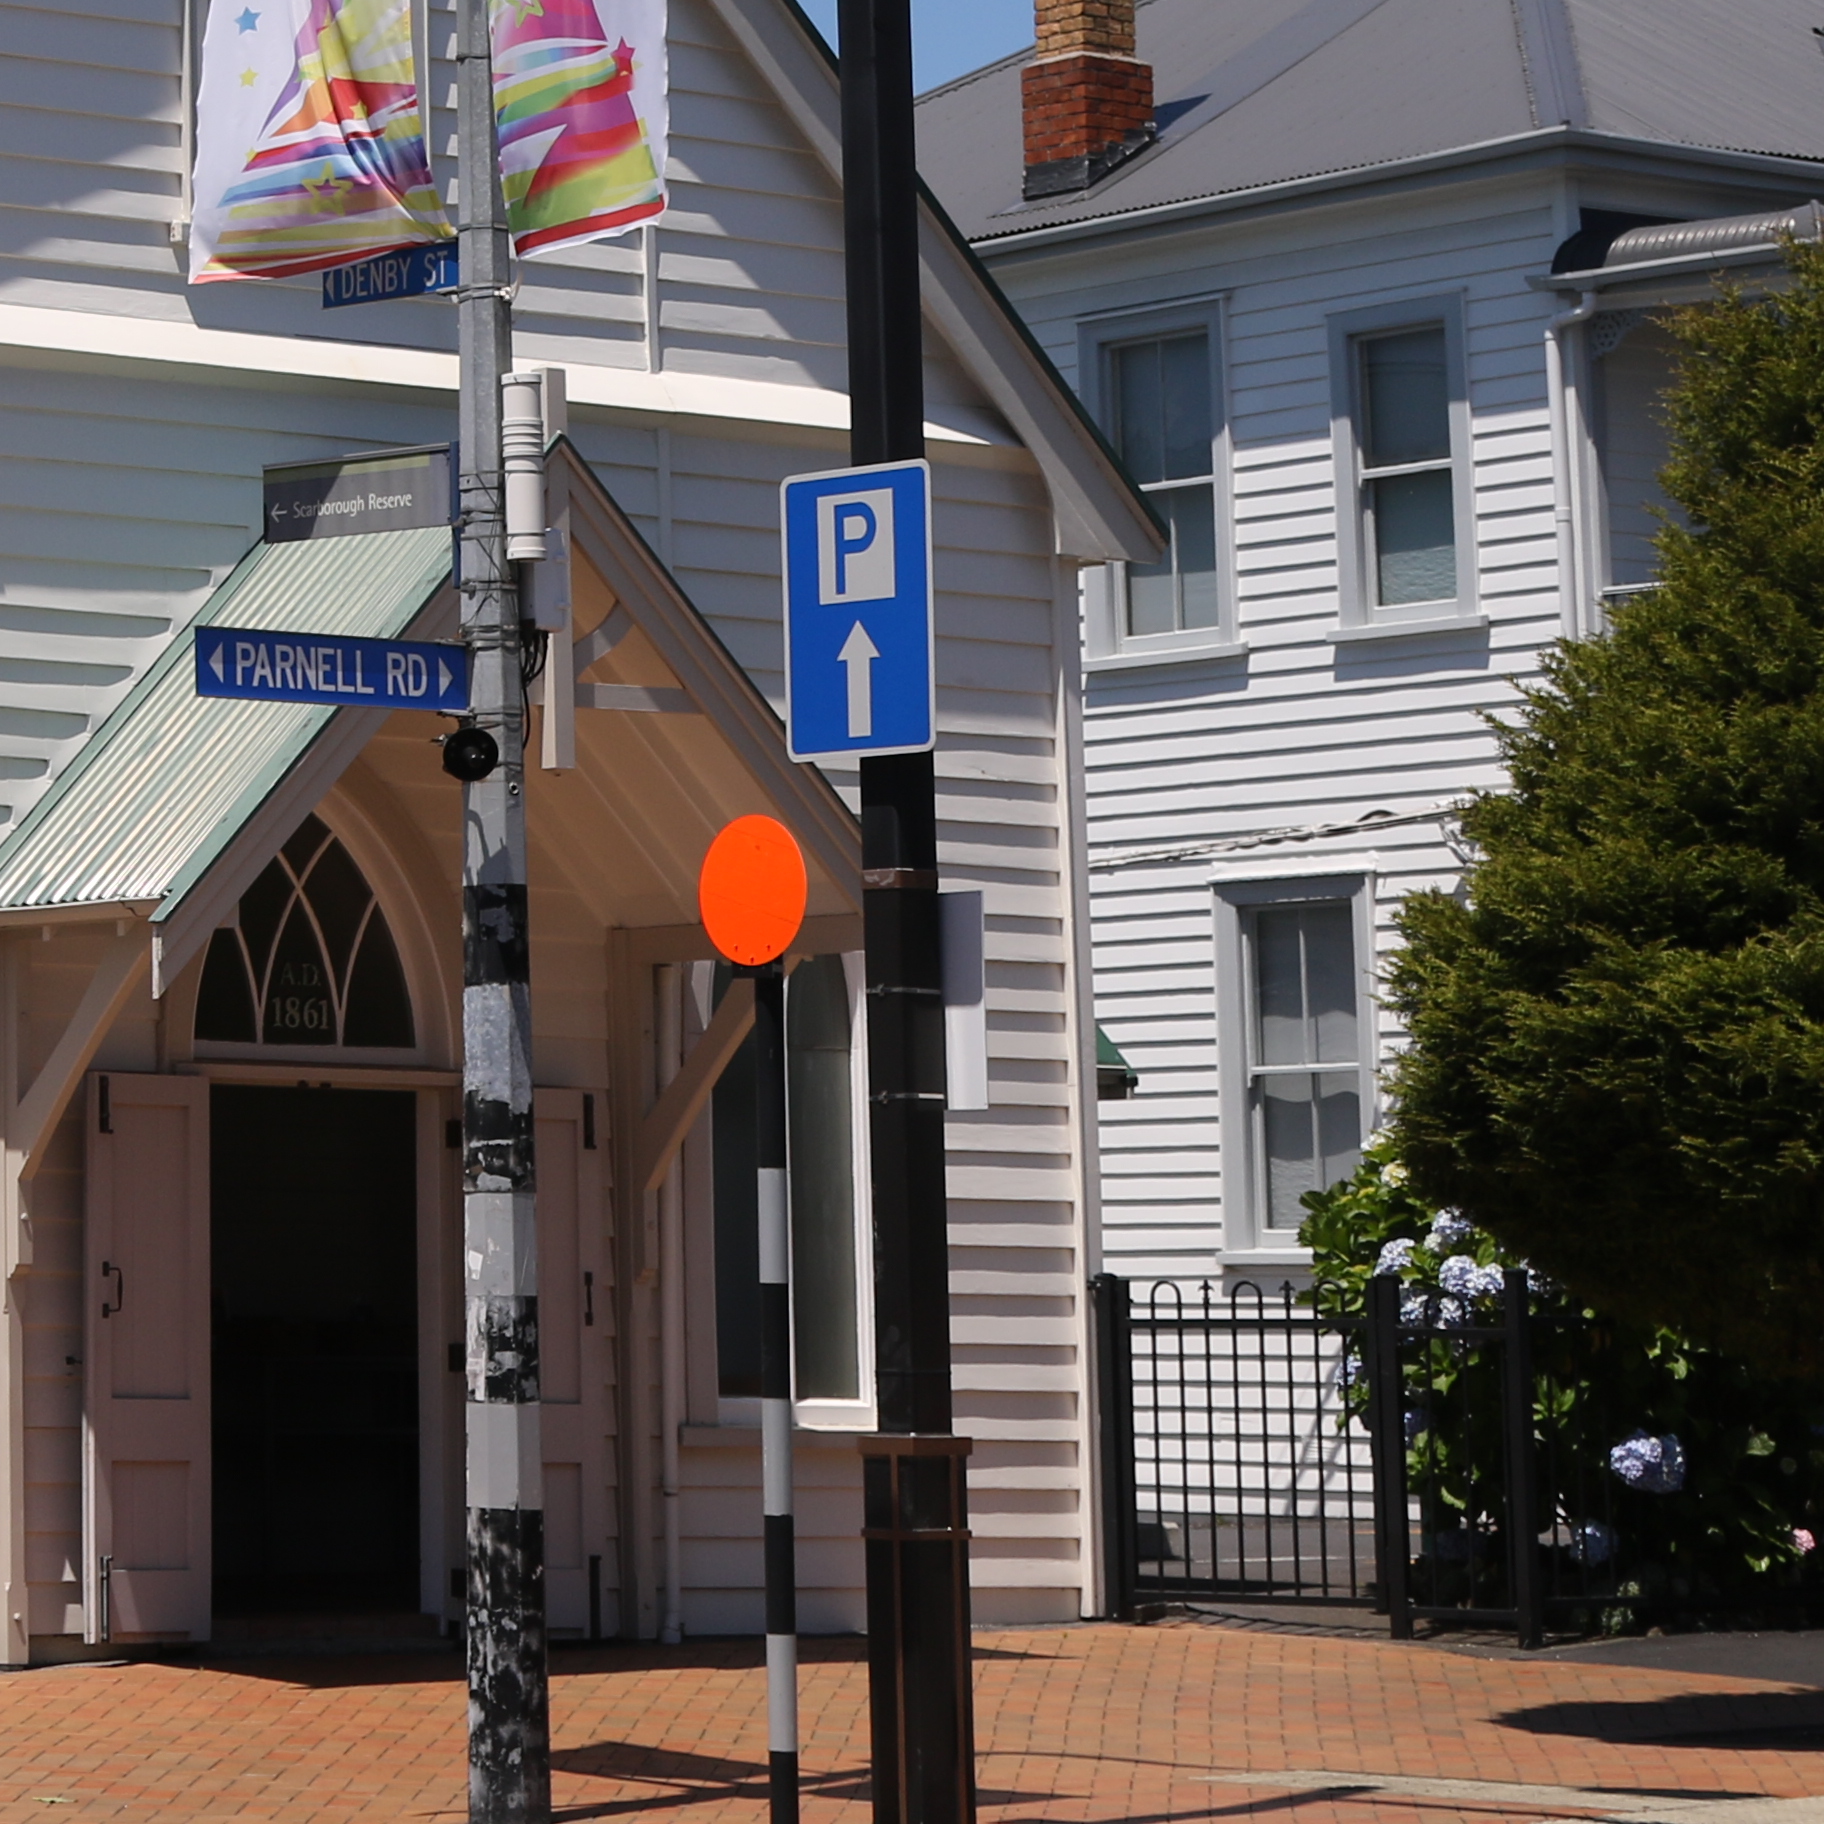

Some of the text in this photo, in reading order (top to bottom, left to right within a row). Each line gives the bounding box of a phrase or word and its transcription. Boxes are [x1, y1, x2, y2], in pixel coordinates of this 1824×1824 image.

[341, 250, 449, 299] DENBY ST
[292, 492, 413, 519] Scarborough Reserve
[833, 501, 877, 595] P
[235, 641, 428, 698] PARNELL RD
[271, 996, 329, 1030] 1861
